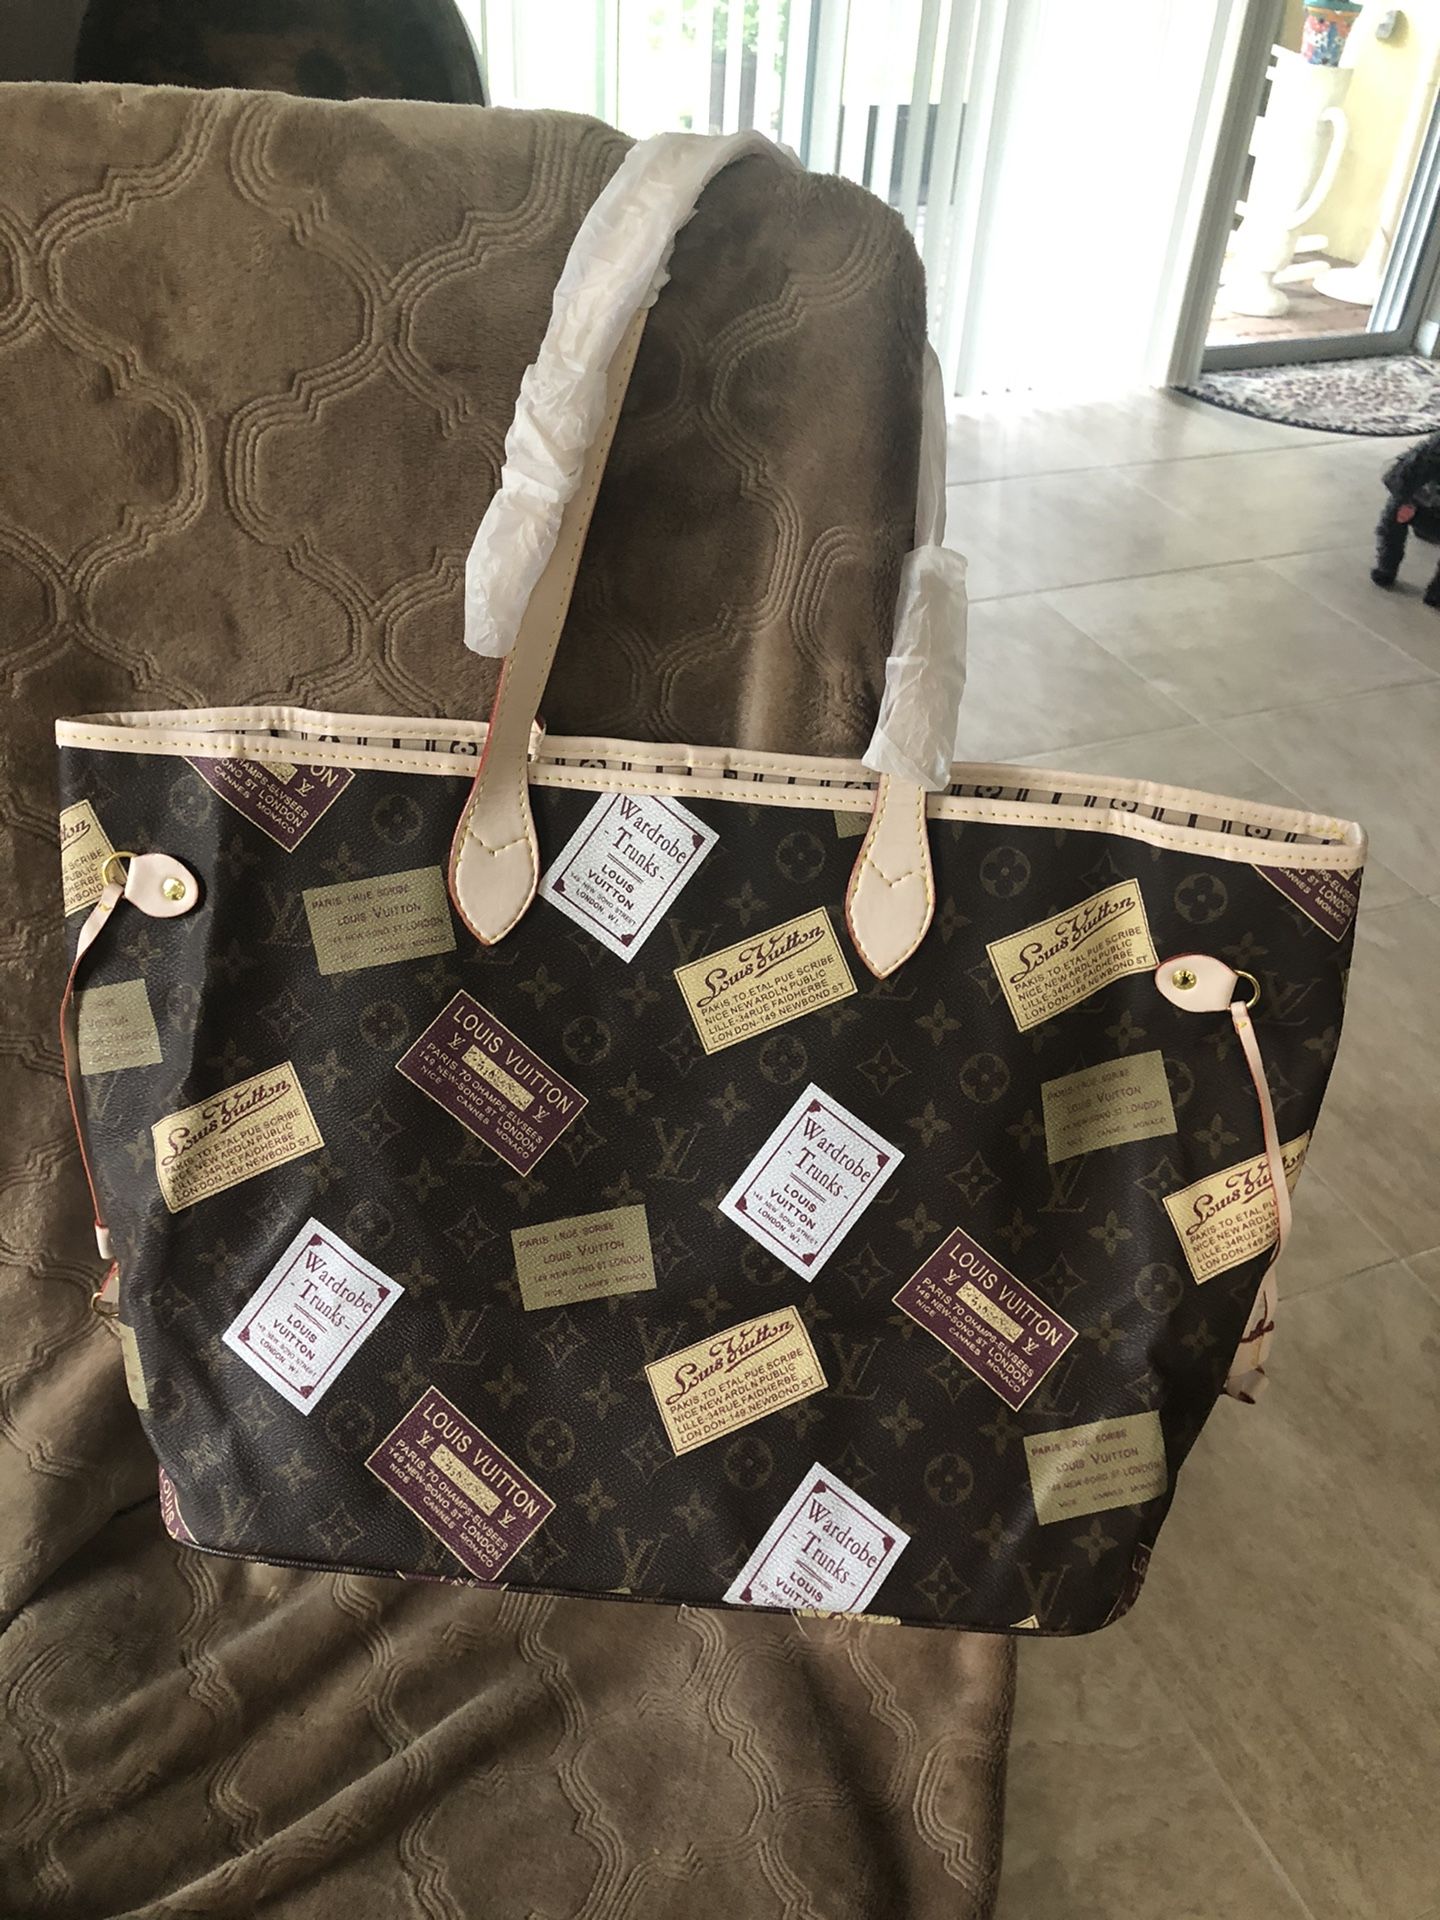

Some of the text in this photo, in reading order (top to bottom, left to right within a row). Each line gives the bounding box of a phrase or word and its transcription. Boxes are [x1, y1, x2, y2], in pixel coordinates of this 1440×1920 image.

[214, 766, 250, 799] CANNES
[256, 802, 295, 834] MONACO
[245, 779, 302, 827] ST LONDON
[619, 796, 686, 863] Wardrobe
[612, 826, 659, 877] Trunks
[587, 869, 634, 910] VUITTON
[600, 863, 634, 893] LOUIS
[372, 898, 421, 918] VUITTON
[1054, 897, 1135, 951] Vuitton
[738, 926, 824, 978] Vuitton
[1062, 953, 1085, 970] ETAL
[1086, 942, 1104, 956] PUE
[1104, 925, 1141, 948] SCRIBE
[1081, 948, 1133, 979] FAIDHERBE
[1135, 953, 1148, 964] ST
[748, 981, 773, 996] ETAL
[774, 970, 795, 985] PUE
[796, 953, 834, 976] SCRIBE
[831, 981, 844, 993] ST
[1017, 984, 1042, 1001] NICE
[1097, 938, 1132, 960] PUBLIC
[704, 1010, 729, 1025] NICE
[788, 968, 826, 990] PUBLIC
[770, 978, 828, 1007] FAIDHERBE
[453, 1005, 573, 1113] LOUIS VUITTON
[458, 1068, 472, 1082] 70
[202, 1073, 291, 1134] Vuitton
[240, 1124, 261, 1139] PUE
[263, 1107, 300, 1129] SCRIBE
[420, 1064, 529, 1159] NICE CANNES MONACO
[238, 1131, 295, 1163] FAIDHERBE
[255, 1121, 293, 1143] PUBLIC
[297, 1134, 310, 1146] ST
[484, 1105, 496, 1116] ST
[496, 1115, 537, 1152] LONDON
[803, 1117, 870, 1182] Wardrobe
[795, 1146, 843, 1196] Trunks
[770, 1188, 816, 1229] VUITTON
[783, 1183, 816, 1212] LOUIS
[1237, 1206, 1261, 1222] ETAL
[518, 1235, 549, 1248] PARIS
[543, 1237, 624, 1264] LOUIS VUITTON
[1193, 1235, 1215, 1252] NICE
[298, 1278, 345, 1326] Trunks
[305, 1250, 372, 1313] Wardrobe
[949, 1243, 1062, 1346] LOUIS VUITTON
[286, 1313, 317, 1343] LOUIS
[951, 1302, 965, 1316] 70
[272, 1319, 315, 1360] VUITTON
[709, 1321, 794, 1373] Vuitton
[914, 1284, 930, 1299] 149
[974, 1336, 987, 1347] ST
[987, 1346, 1028, 1386] LONDON
[915, 1298, 1021, 1392] NICE CANNES MONACO
[718, 1376, 743, 1391] ETAL
[743, 1365, 765, 1380] PUE
[766, 1347, 803, 1370] SCRIBE
[740, 1373, 798, 1404] FAIDHERBE
[801, 1375, 814, 1387] ST
[673, 1407, 698, 1424] NICE
[758, 1362, 796, 1384] PUBLIC
[422, 1402, 539, 1518] LOUIS VUITTON
[425, 1469, 439, 1483] 70
[1090, 1444, 1138, 1465] VUITTON
[388, 1447, 404, 1463] 149
[449, 1508, 463, 1520] ST
[462, 1519, 502, 1560] LONDON
[422, 1495, 456, 1529] CANNES
[459, 1531, 493, 1567] MONACO
[808, 1498, 876, 1568] Wardrobe
[800, 1530, 849, 1583] Trunks
[775, 1576, 816, 1611] VUITTO
[789, 1571, 823, 1602] LOUIS
